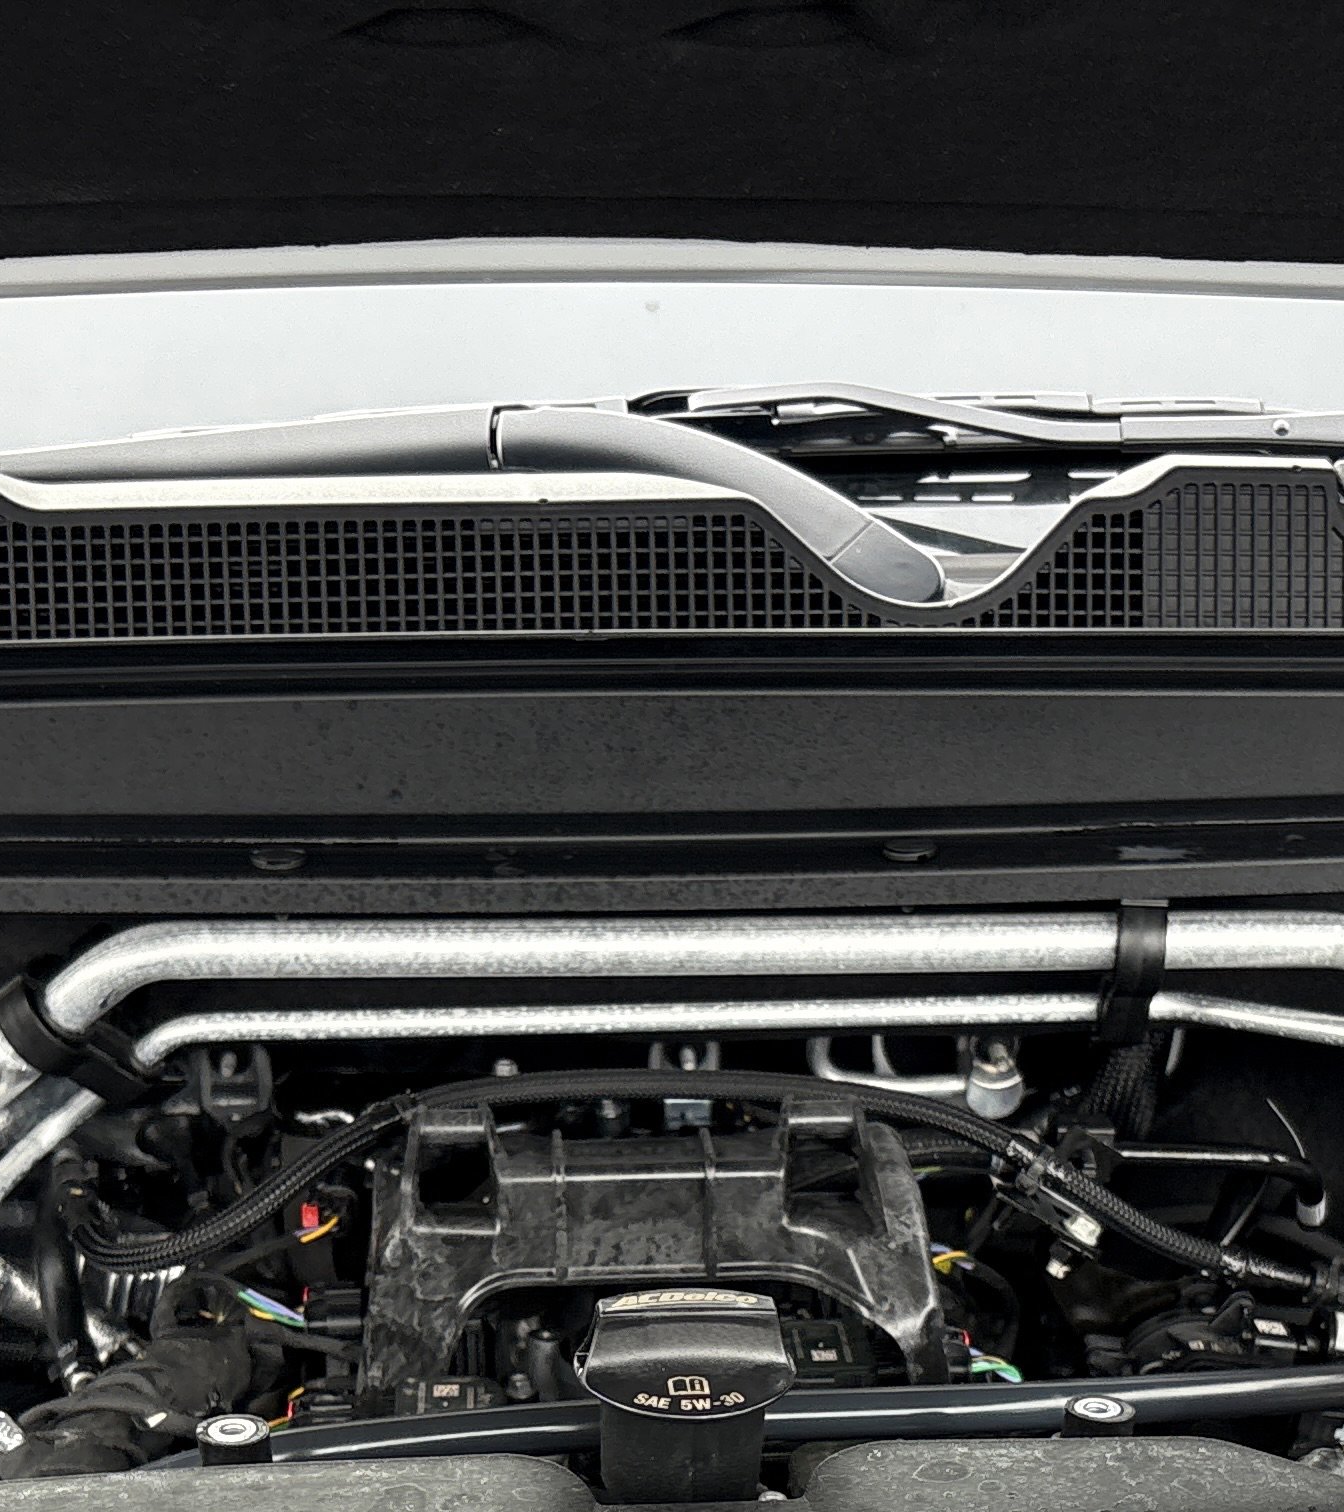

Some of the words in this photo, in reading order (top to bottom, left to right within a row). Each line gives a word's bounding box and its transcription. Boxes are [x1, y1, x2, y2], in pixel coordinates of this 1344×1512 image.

[612, 1293, 758, 1307] ACDelco
[633, 1393, 672, 1410] SAE
[680, 1391, 745, 1411] 5W-30
